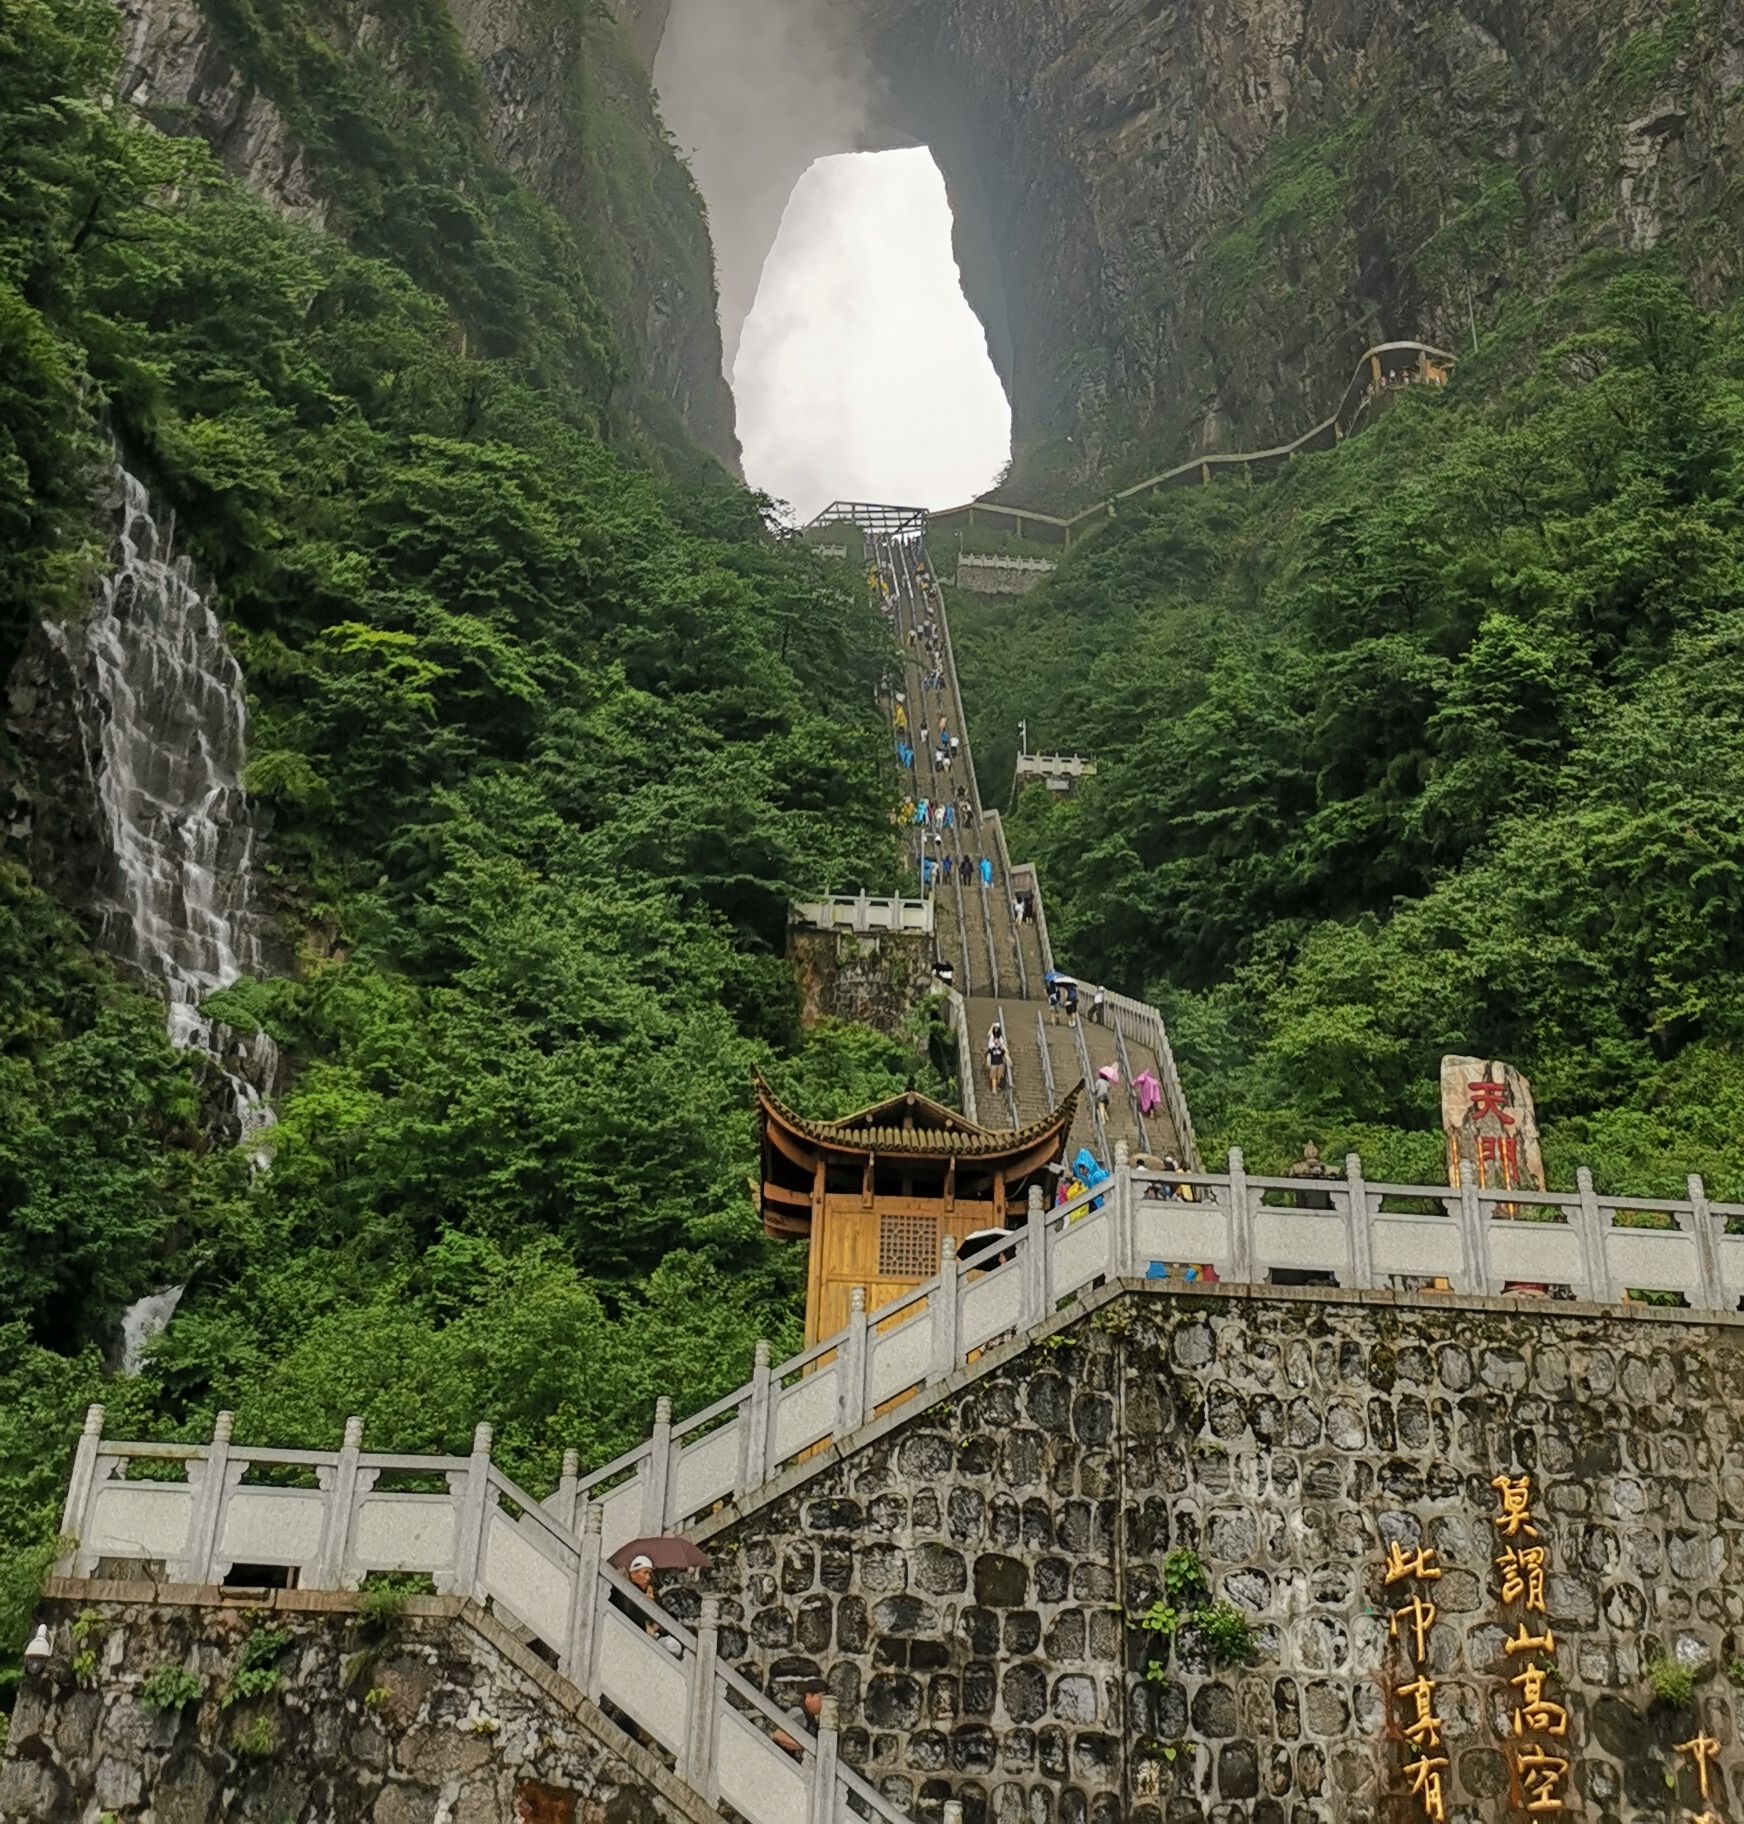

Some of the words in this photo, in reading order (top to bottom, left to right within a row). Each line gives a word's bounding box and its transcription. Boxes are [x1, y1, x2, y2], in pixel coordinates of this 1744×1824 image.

[1468, 1081, 1519, 1183] 天門
[1384, 1540, 1449, 1822] 此中真有
[1491, 1475, 1569, 1824] 莫謂山高空
